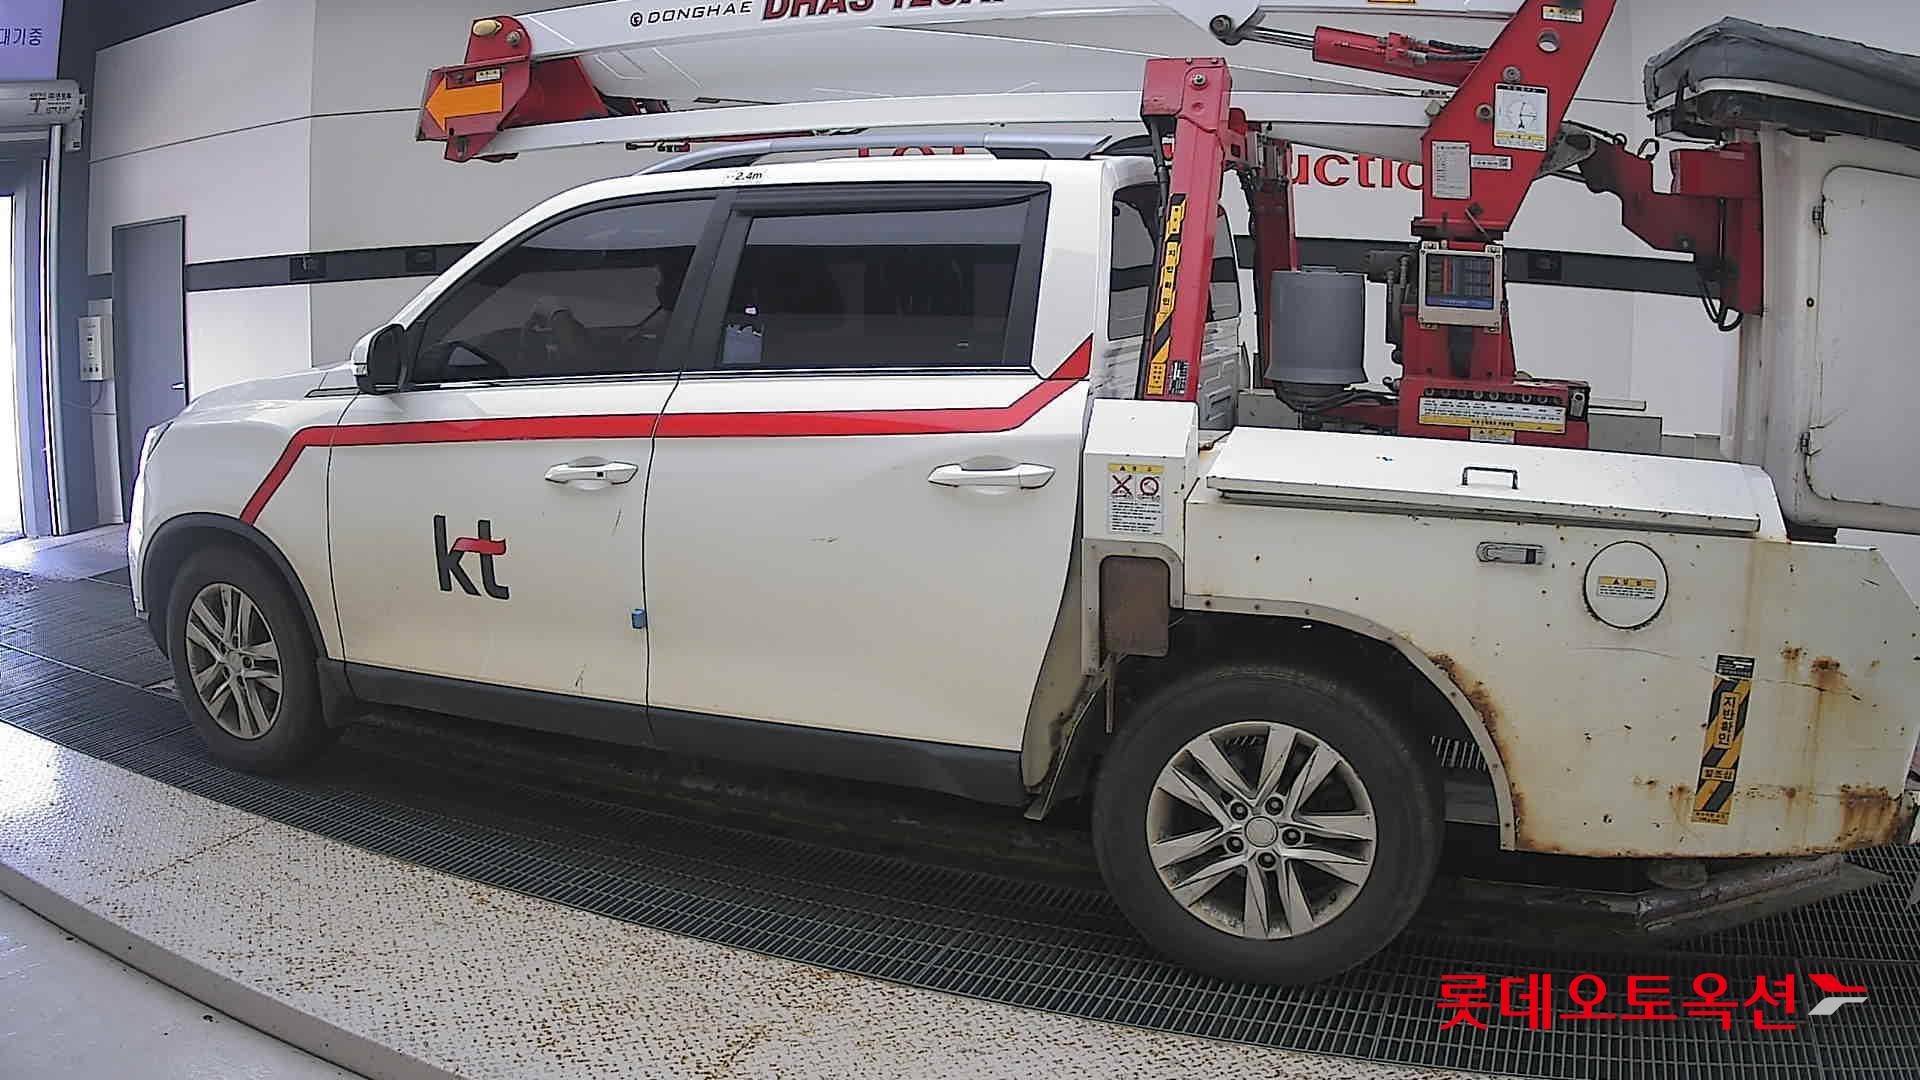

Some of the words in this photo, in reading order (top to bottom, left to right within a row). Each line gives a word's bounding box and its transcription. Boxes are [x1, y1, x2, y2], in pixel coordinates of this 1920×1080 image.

[647, 1, 753, 24] DONGHAE
[0, 27, 42, 46] 대기중
[433, 514, 510, 600] kt
